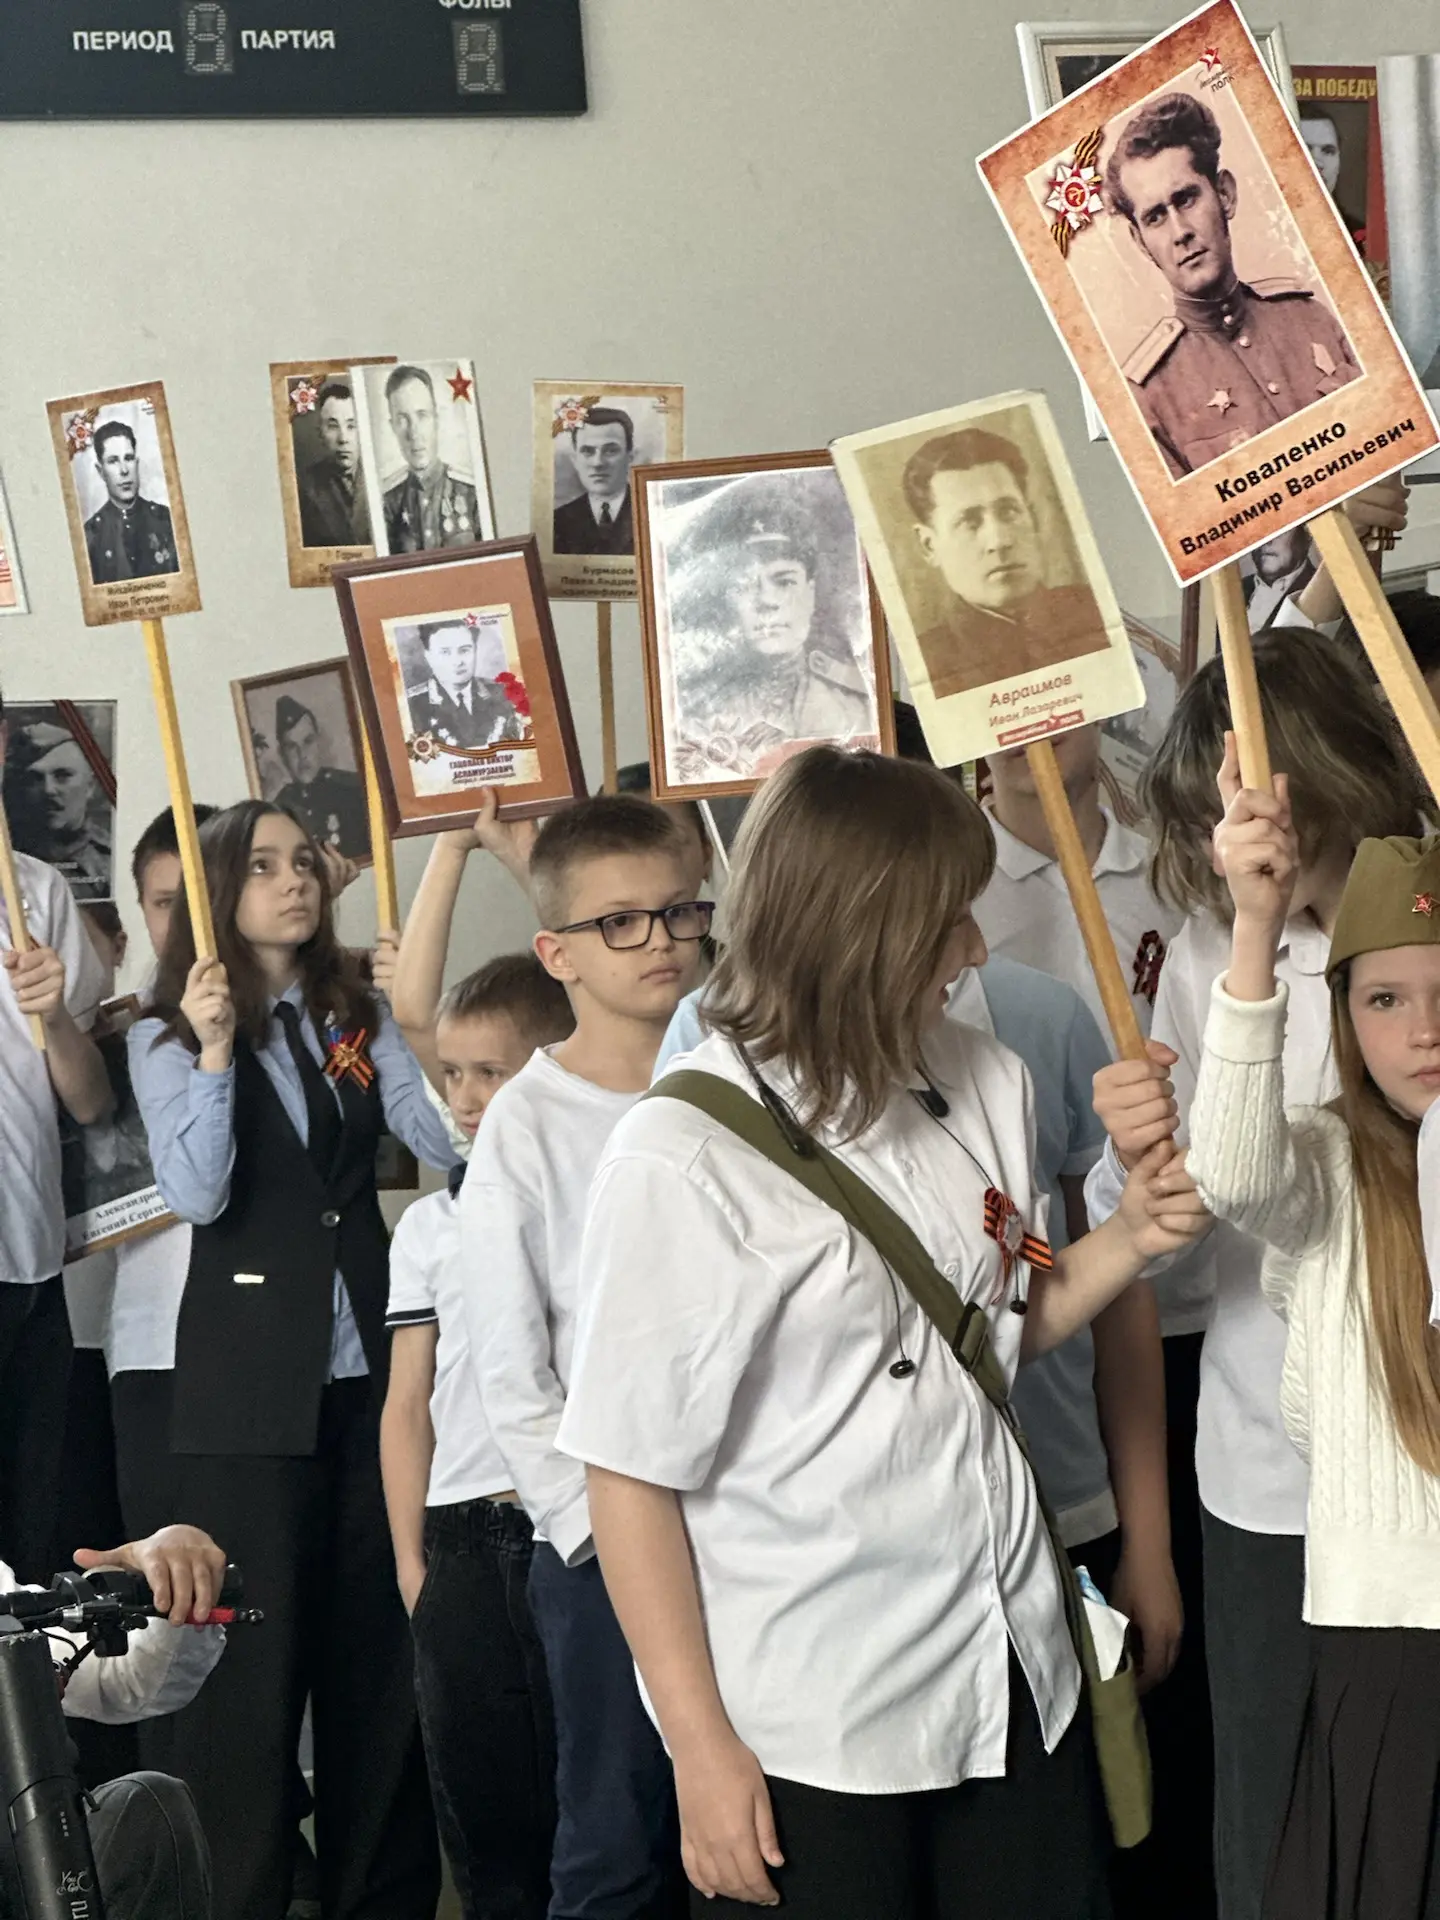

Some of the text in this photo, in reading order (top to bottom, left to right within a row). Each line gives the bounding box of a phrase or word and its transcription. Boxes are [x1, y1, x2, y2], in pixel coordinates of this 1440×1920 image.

[72, 30, 174, 53] ПЕРИОД
[240, 30, 336, 49] ПАРТИЯ
[1293, 78, 1377, 99] ЗА ПОБЕДУ
[1214, 422, 1347, 503] Коваленко
[1179, 418, 1416, 556] Владимир Васильевич
[989, 674, 1073, 706] Авраимов
[988, 711, 1020, 727] Иван
